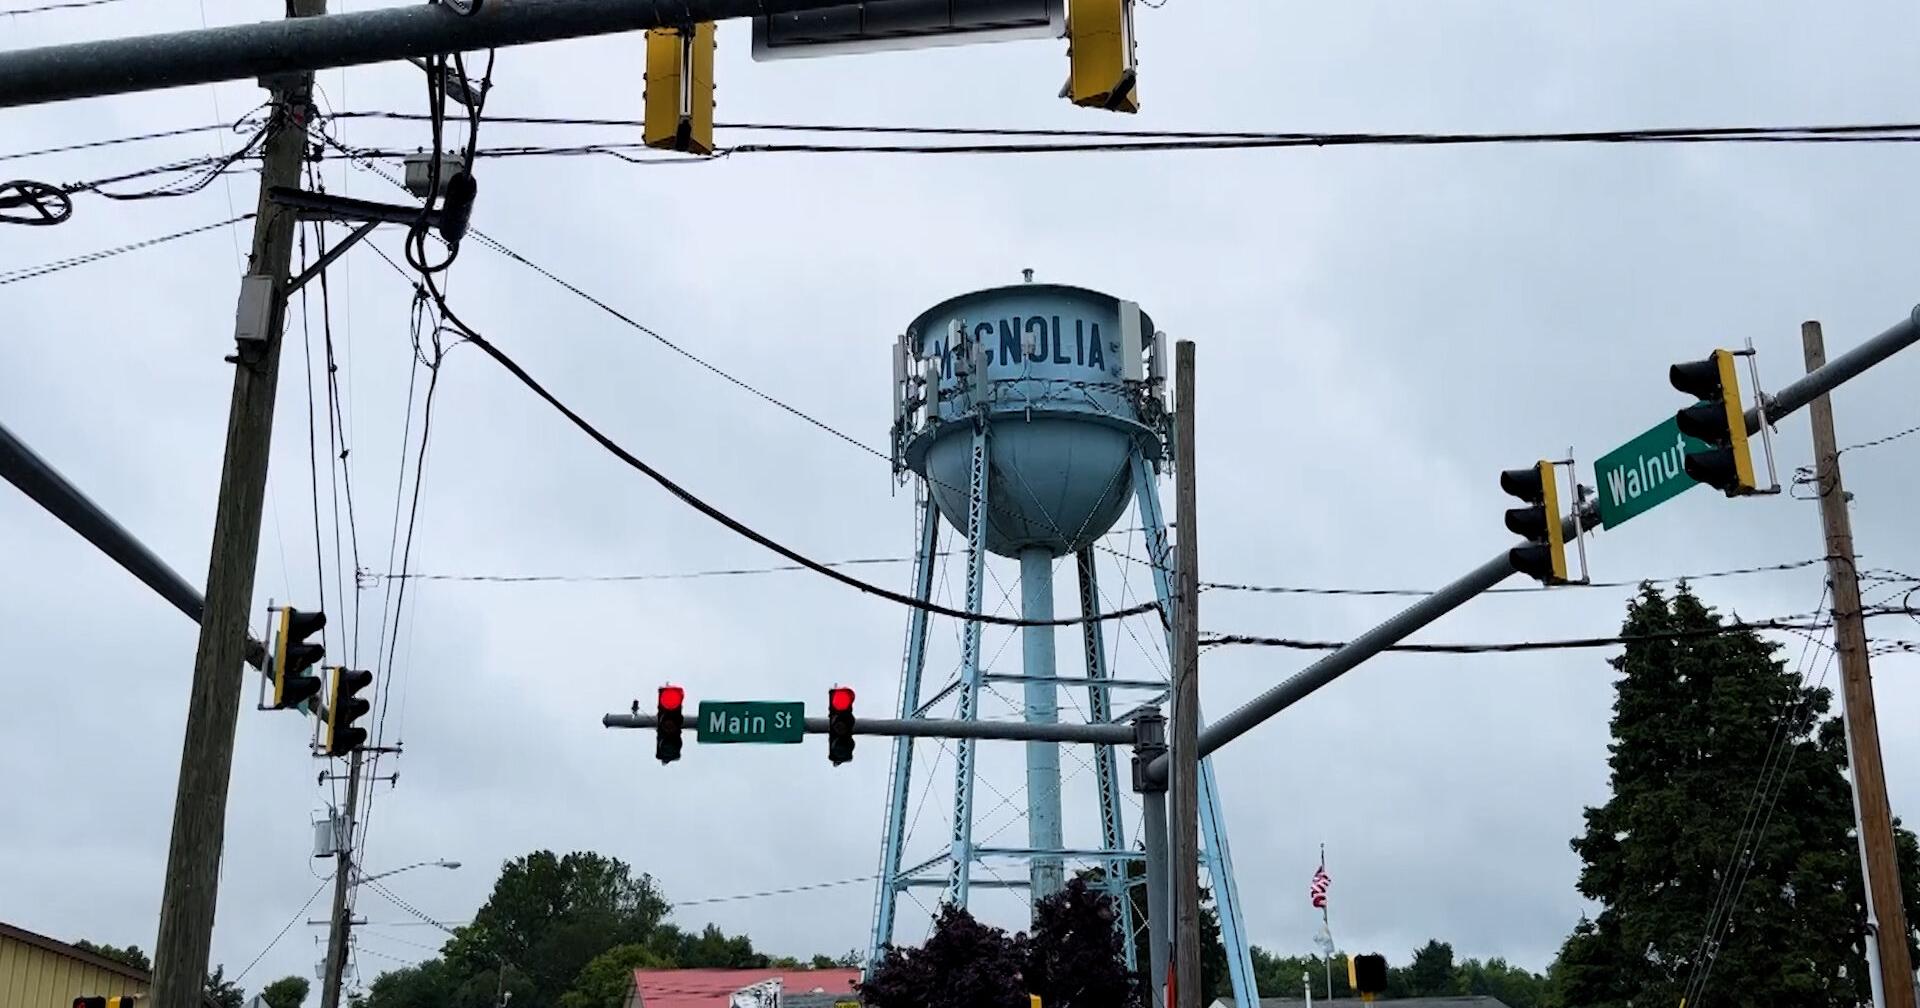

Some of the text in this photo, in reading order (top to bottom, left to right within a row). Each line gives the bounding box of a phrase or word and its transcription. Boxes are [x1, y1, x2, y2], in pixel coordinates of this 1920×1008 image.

[933, 315, 1106, 379] MGNOLIA
[1607, 432, 1687, 507] Walnut
[709, 711, 793, 734] Main St
